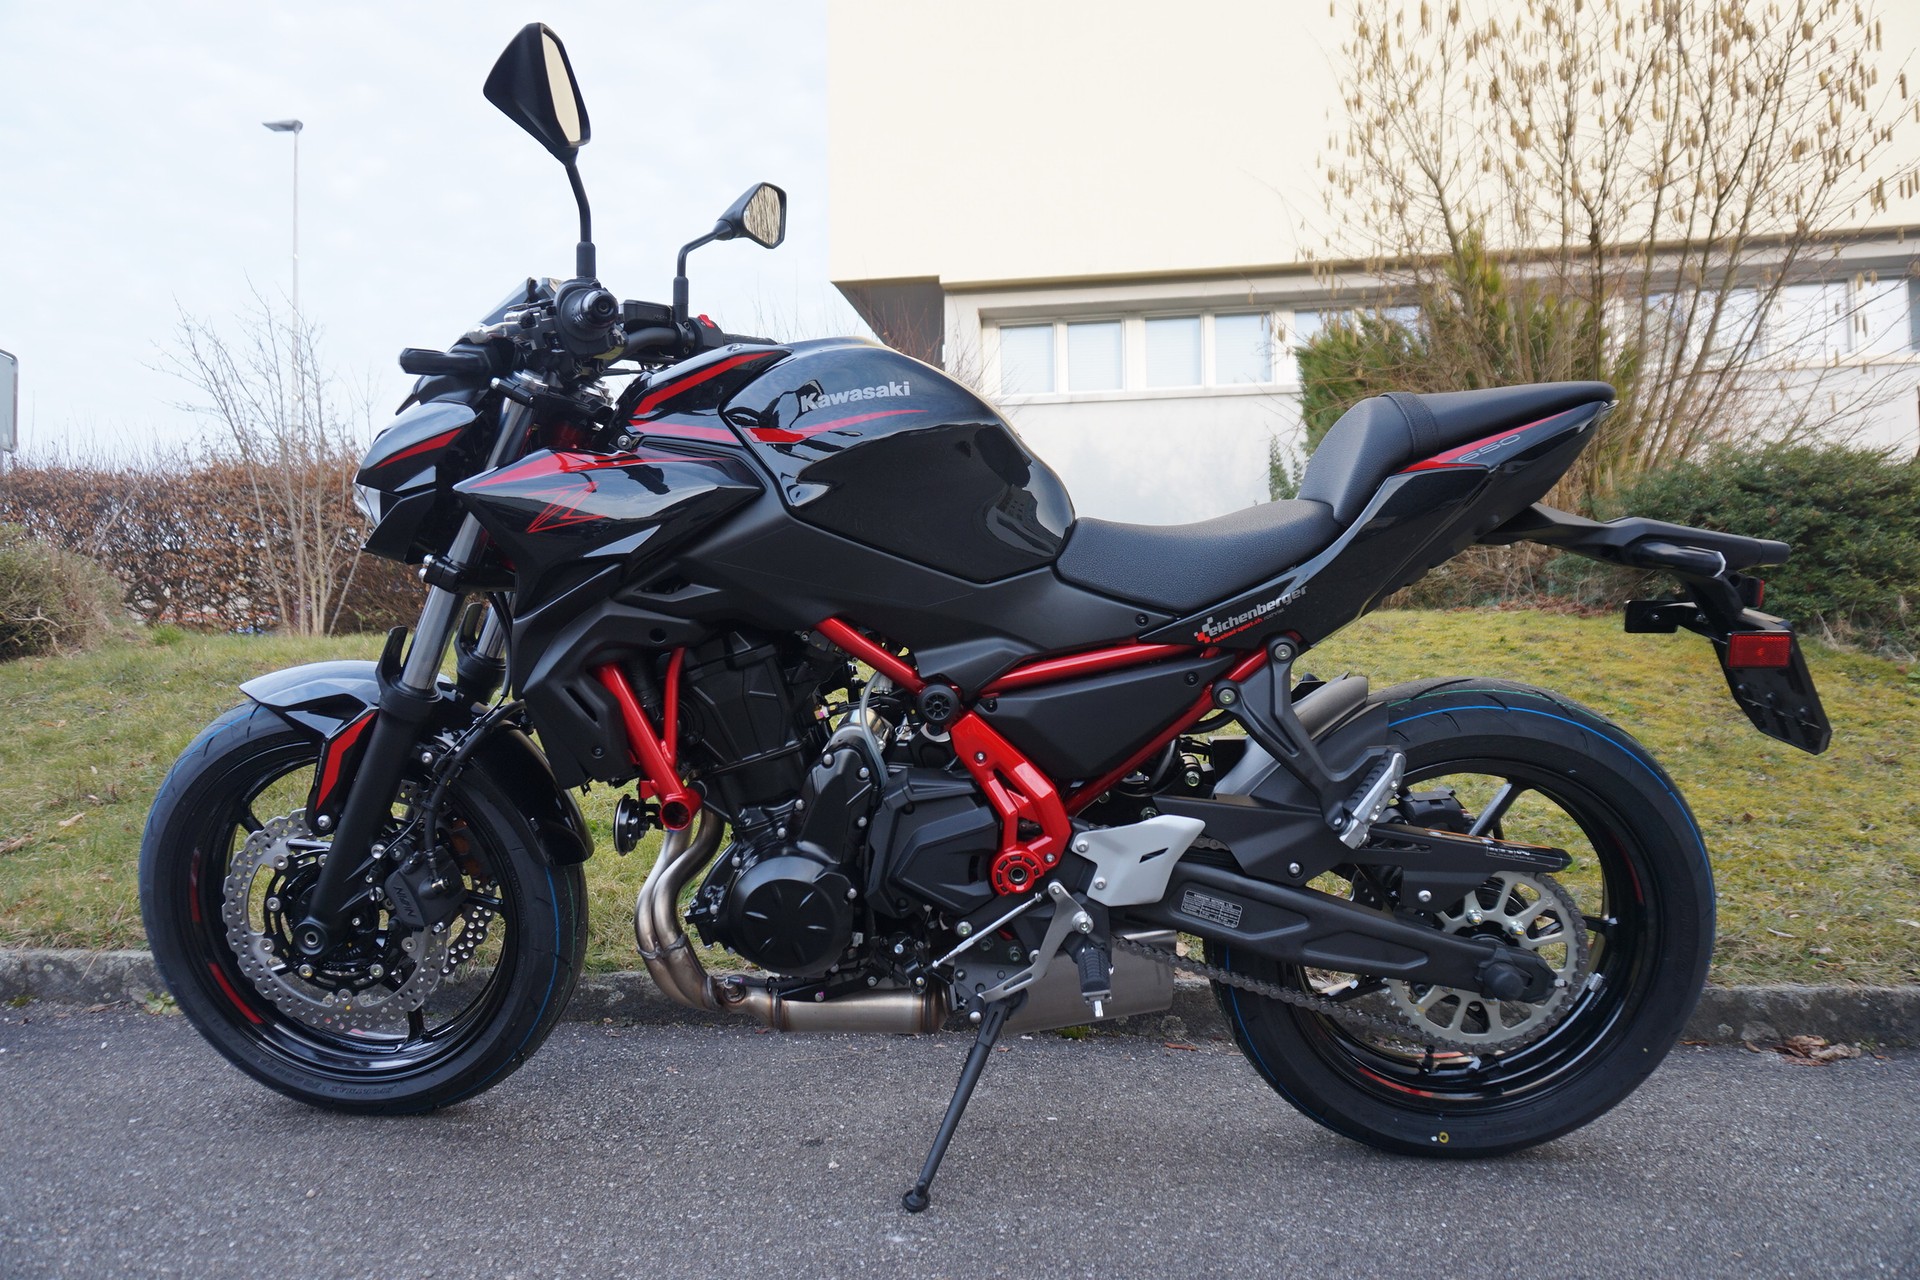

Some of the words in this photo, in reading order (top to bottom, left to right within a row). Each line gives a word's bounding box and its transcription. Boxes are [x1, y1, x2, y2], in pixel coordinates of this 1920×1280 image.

[800, 381, 911, 413] Kawasaki
[1458, 434, 1520, 463] 650
[1208, 585, 1308, 637] eichenberger
